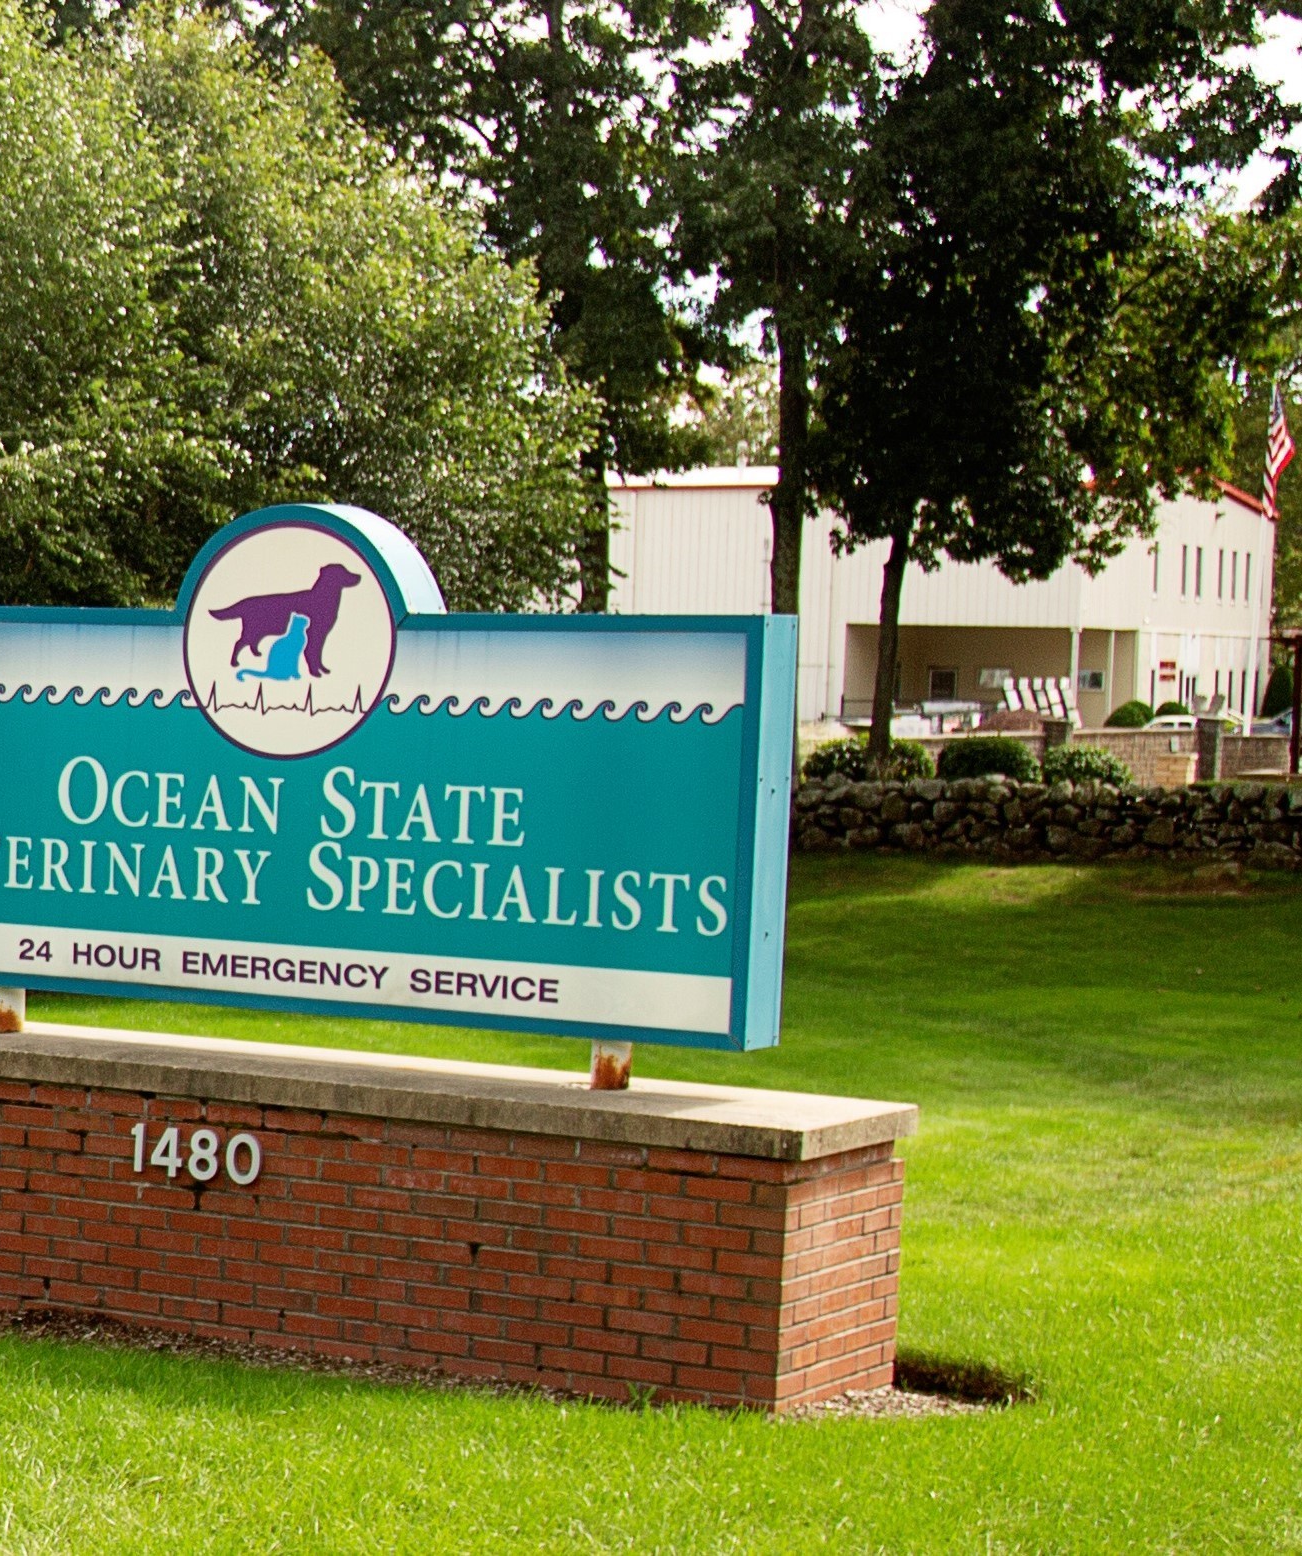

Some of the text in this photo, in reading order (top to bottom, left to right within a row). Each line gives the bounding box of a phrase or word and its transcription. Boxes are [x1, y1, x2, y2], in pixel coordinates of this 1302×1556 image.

[57, 755, 525, 847] OCEAN STATE
[307, 841, 728, 936] SPECIALISTS
[18, 937, 559, 1003] 24 HOUR EMERGENCY SERVICE
[131, 1122, 261, 1186] 1480
